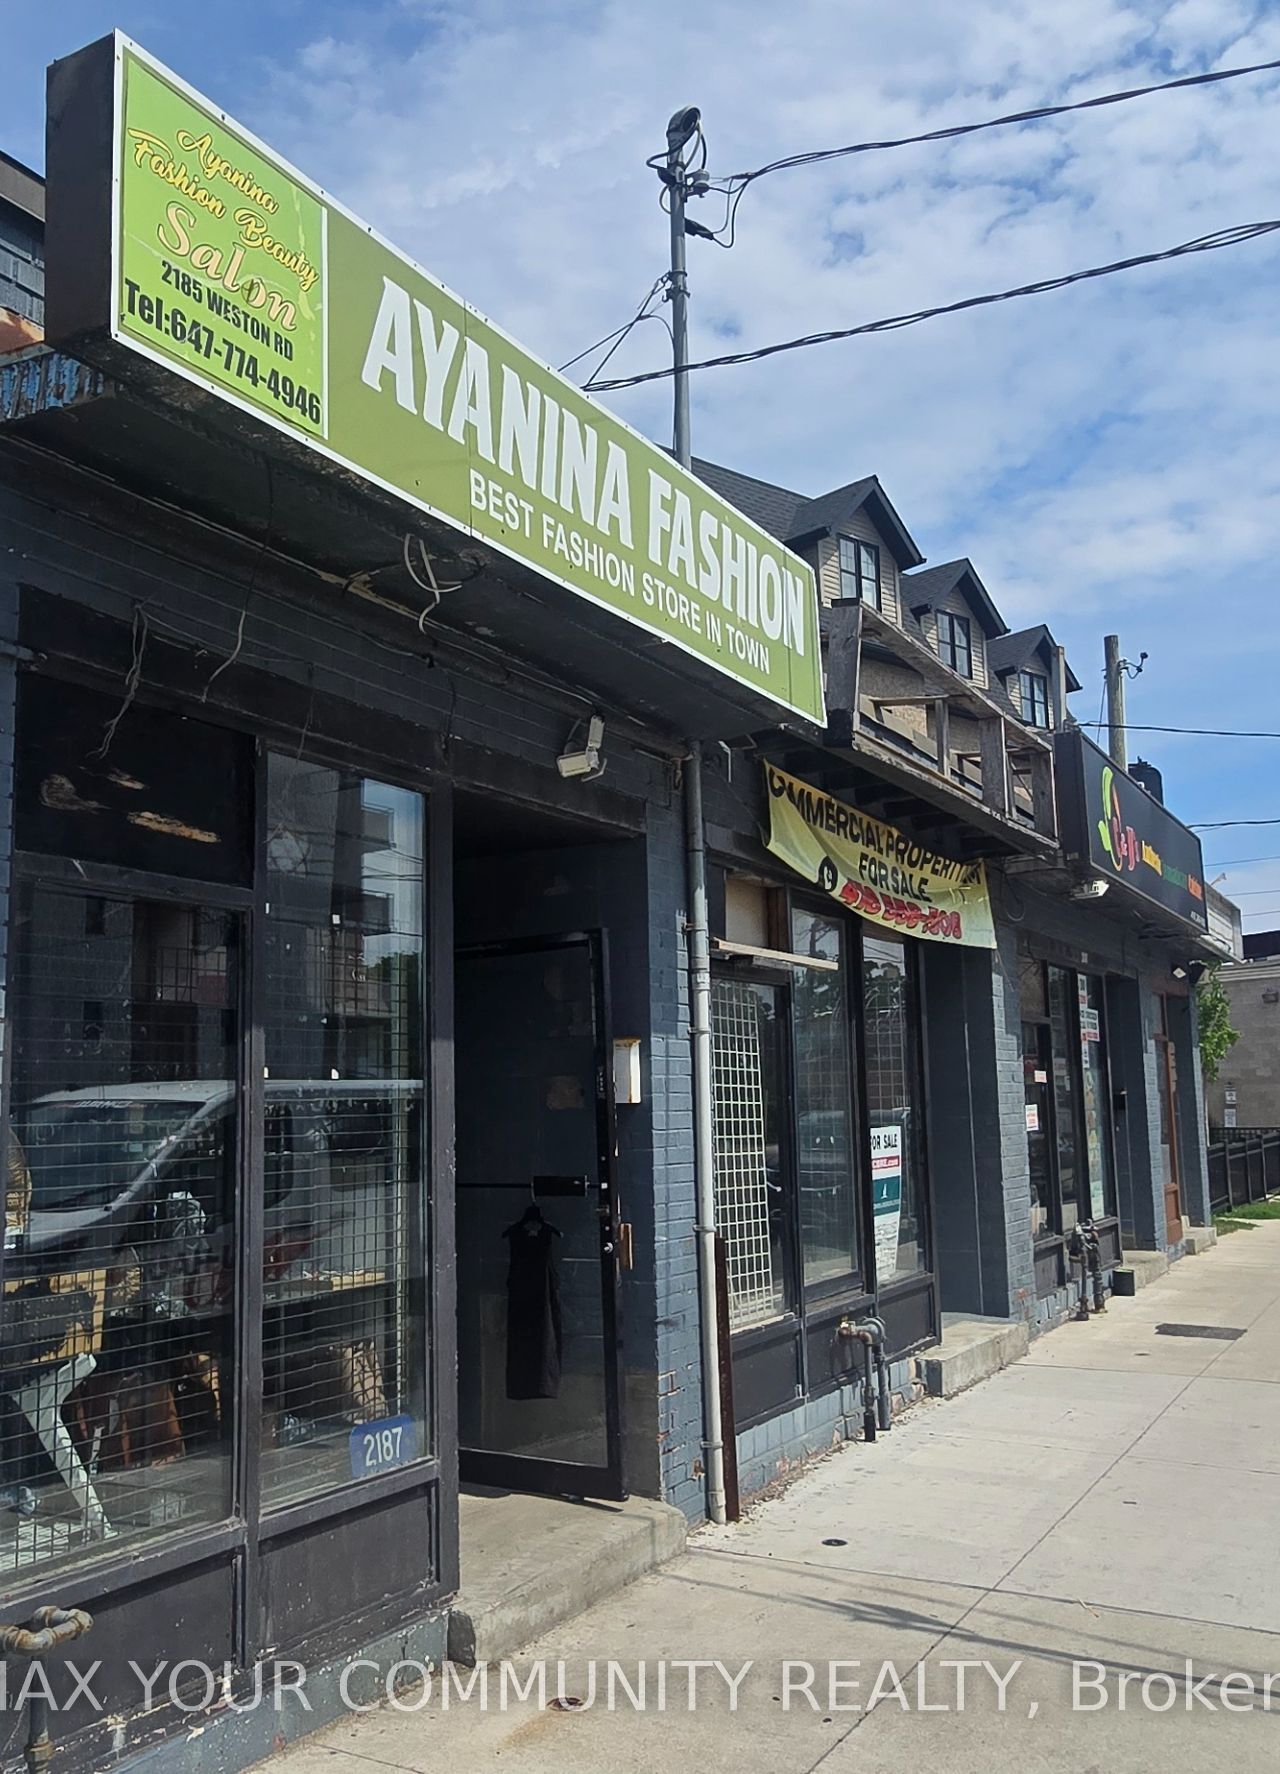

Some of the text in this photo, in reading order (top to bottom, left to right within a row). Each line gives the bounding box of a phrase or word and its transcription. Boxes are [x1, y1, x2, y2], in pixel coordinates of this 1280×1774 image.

[128, 128, 319, 291] Fashion Beauty
[177, 130, 279, 214] Ayanina
[157, 201, 297, 331] Salon
[161, 260, 294, 361] 2185 WESTON RD
[125, 278, 321, 425] Tel:647-774-4946
[361, 275, 805, 657] AYANINA FASHION
[469, 468, 770, 674] BEST FASHION STORE IN TOWN
[859, 851, 933, 903] FOR SALE
[883, 1133, 898, 1149] SALE
[363, 1426, 402, 1467] 2187
